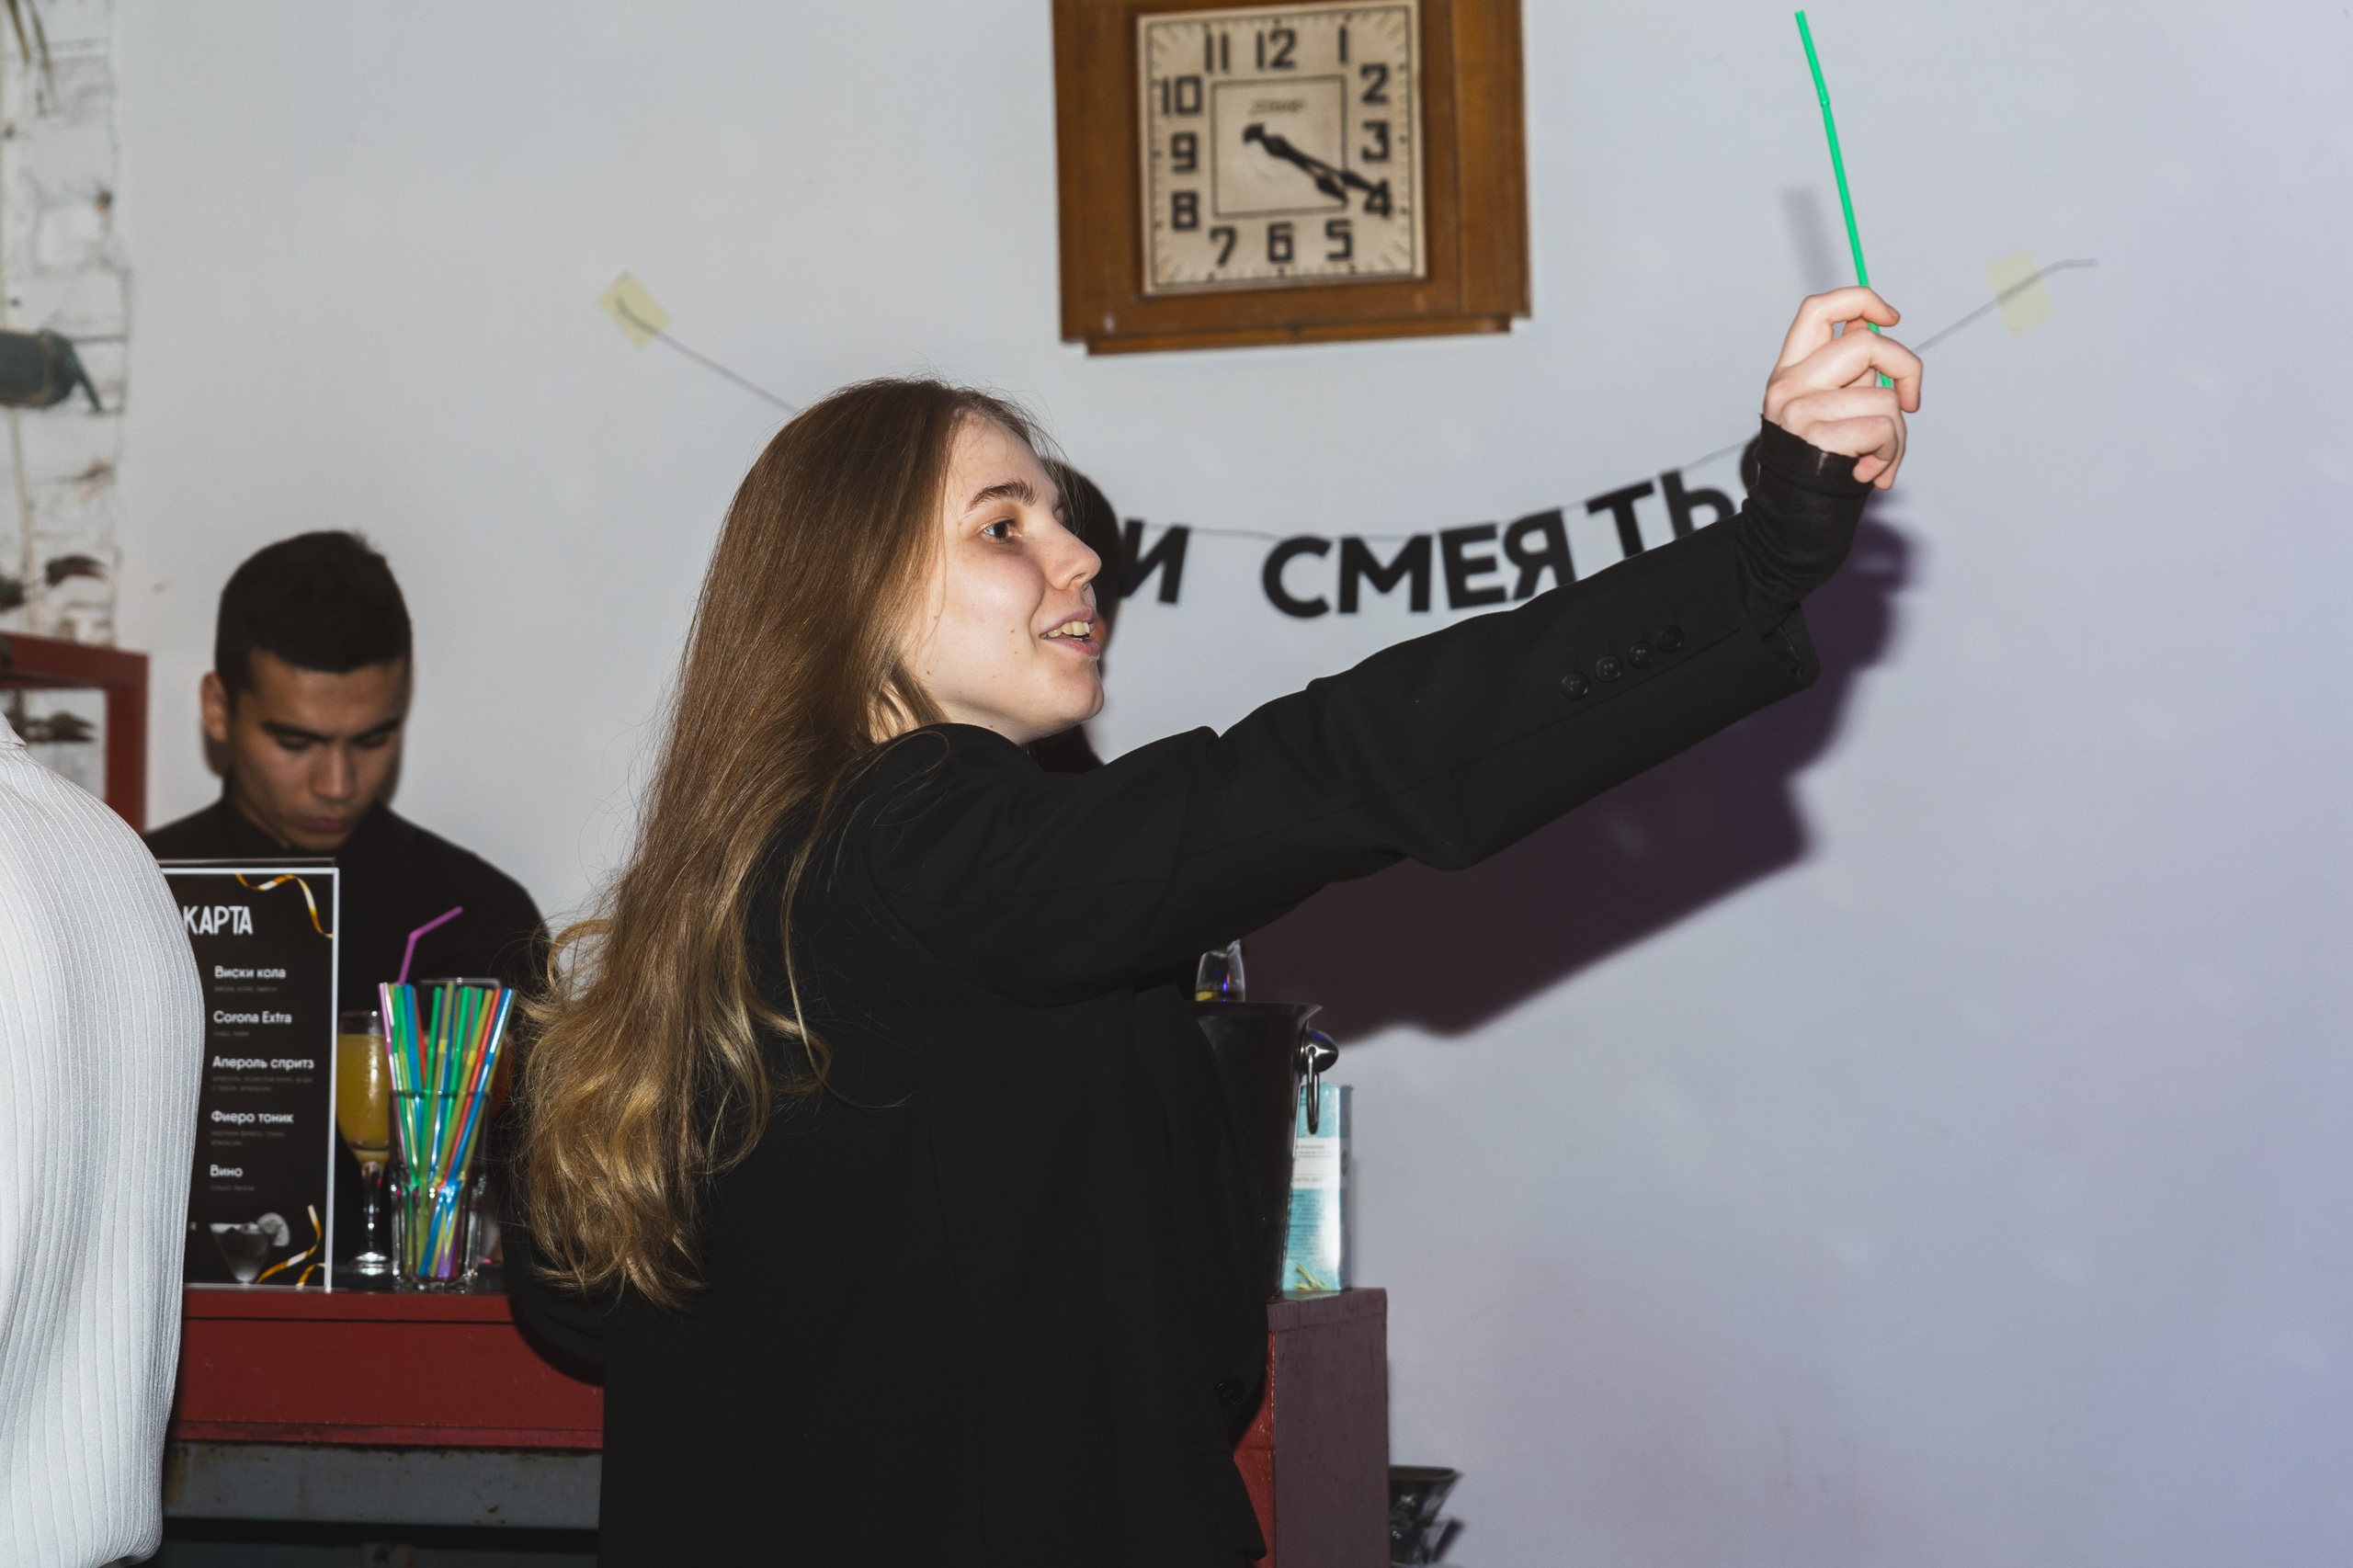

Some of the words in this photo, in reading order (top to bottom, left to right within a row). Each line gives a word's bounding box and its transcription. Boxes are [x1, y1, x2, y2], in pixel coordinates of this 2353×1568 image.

[1204, 30, 1230, 74] 11
[1256, 28, 1296, 71] 12
[1338, 25, 1349, 65] 1
[1161, 74, 1202, 116] 10
[1360, 62, 1390, 105] 2
[1171, 131, 1198, 174] 9
[1360, 119, 1391, 163] 3
[1171, 190, 1199, 232] 8
[1362, 180, 1392, 220] 4
[1209, 226, 1237, 267] 7
[1267, 222, 1294, 264] 6
[1325, 220, 1353, 261] 5
[184, 905, 254, 936] КАРТА
[214, 965, 255, 979] Виски
[256, 968, 287, 979] кола
[213, 1010, 259, 1024] Corona
[262, 1011, 292, 1024] Extra
[212, 1055, 268, 1071] Апероль
[270, 1058, 314, 1072] спритз
[210, 1109, 256, 1125] Фиеро
[257, 1112, 294, 1124] тоник
[210, 1164, 244, 1177] Вино
